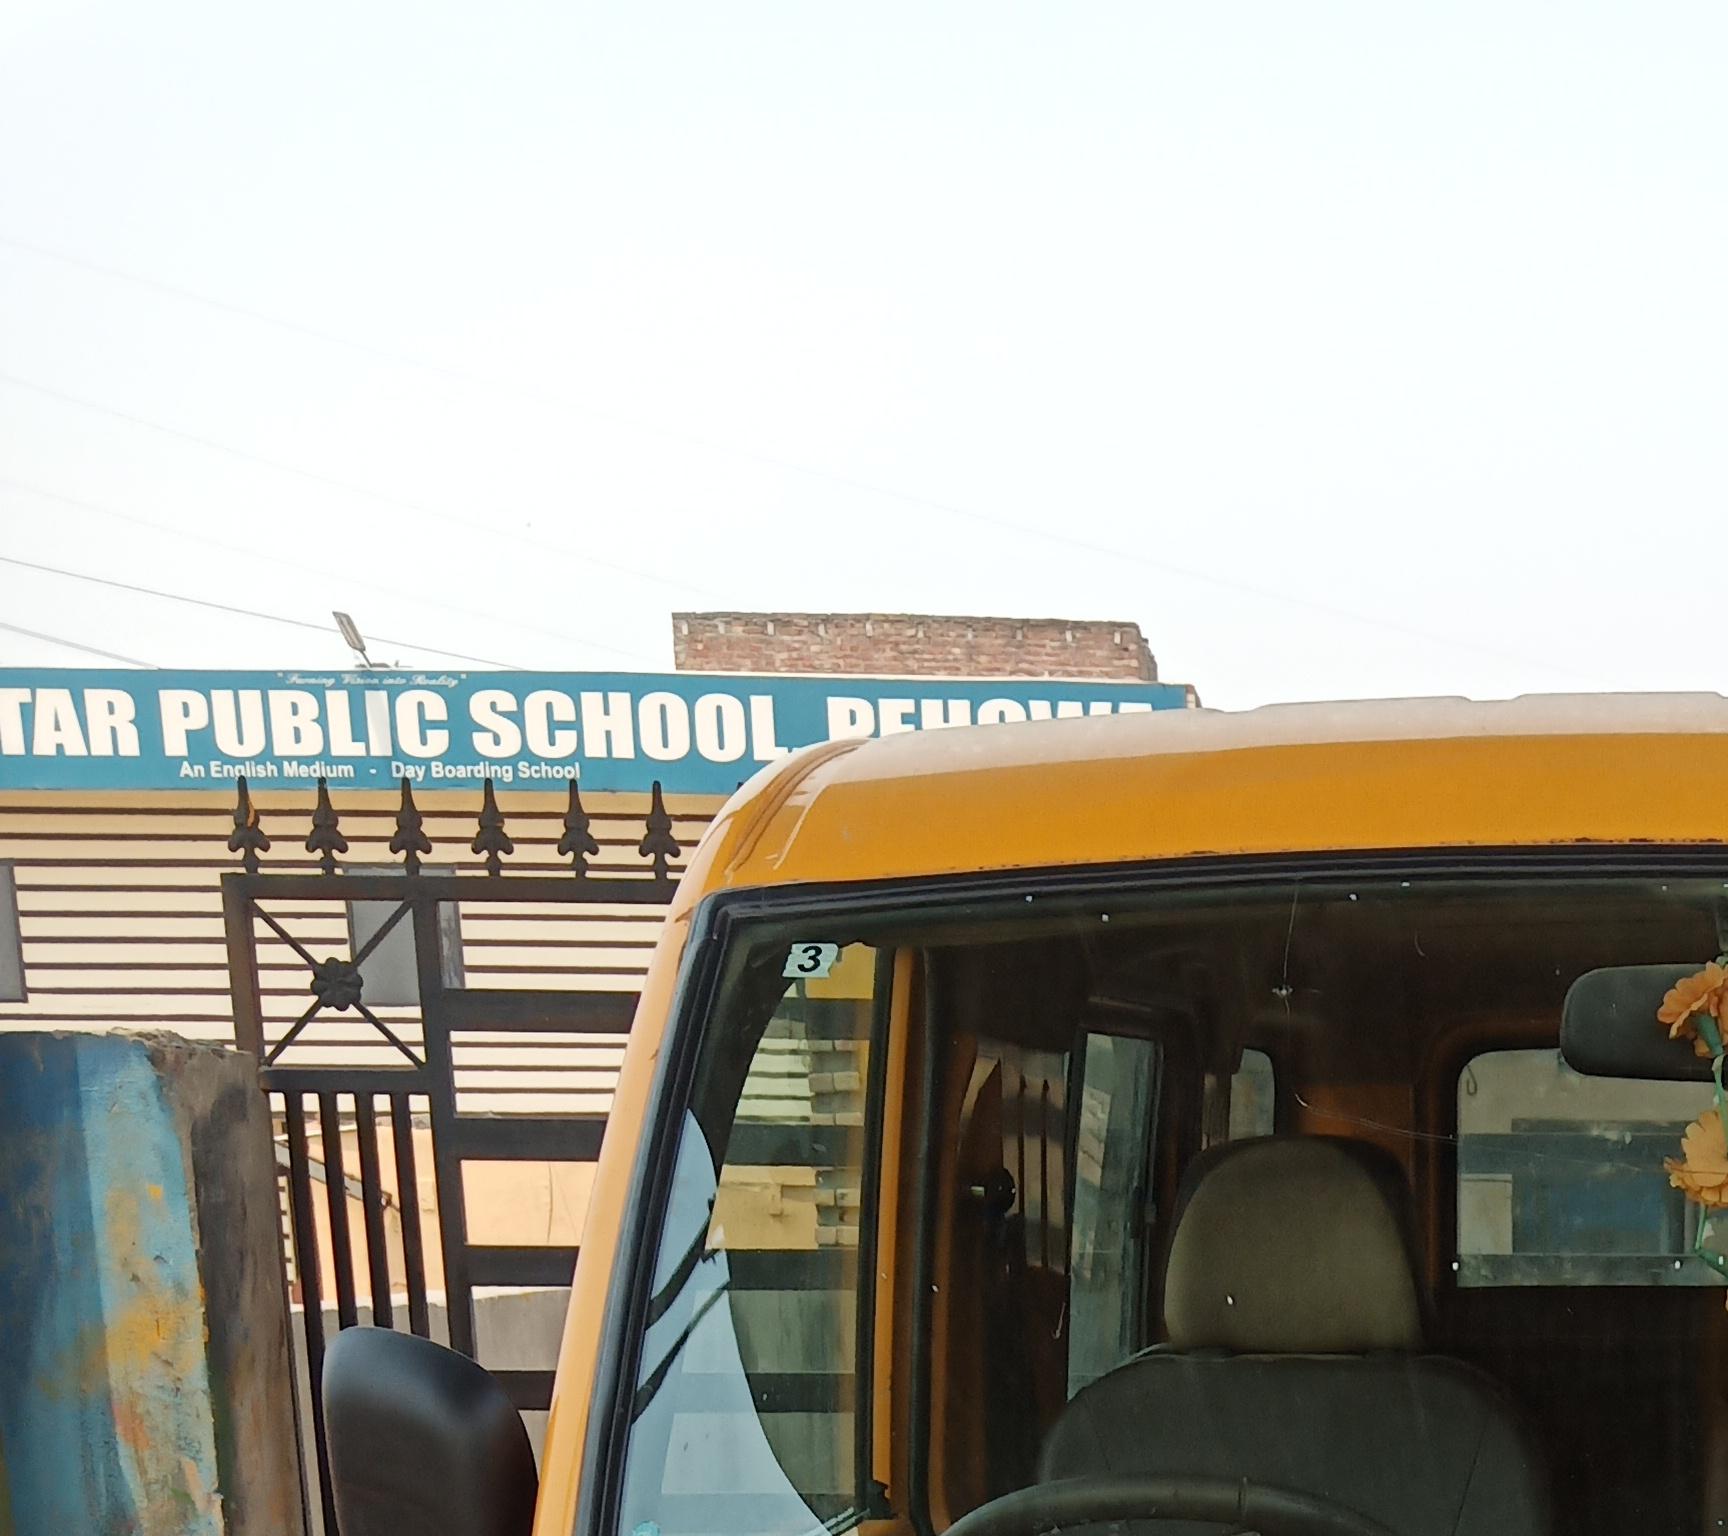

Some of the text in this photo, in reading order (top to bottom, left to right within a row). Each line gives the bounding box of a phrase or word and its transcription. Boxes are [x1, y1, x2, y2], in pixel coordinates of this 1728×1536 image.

[158, 689, 449, 757] PUBLIC
[179, 760, 206, 778] An
[209, 760, 279, 782] English
[282, 760, 355, 778] Medium
[391, 760, 426, 781] Day
[430, 760, 514, 783] Boarding
[517, 761, 581, 779] School
[797, 945, 823, 973] 3
